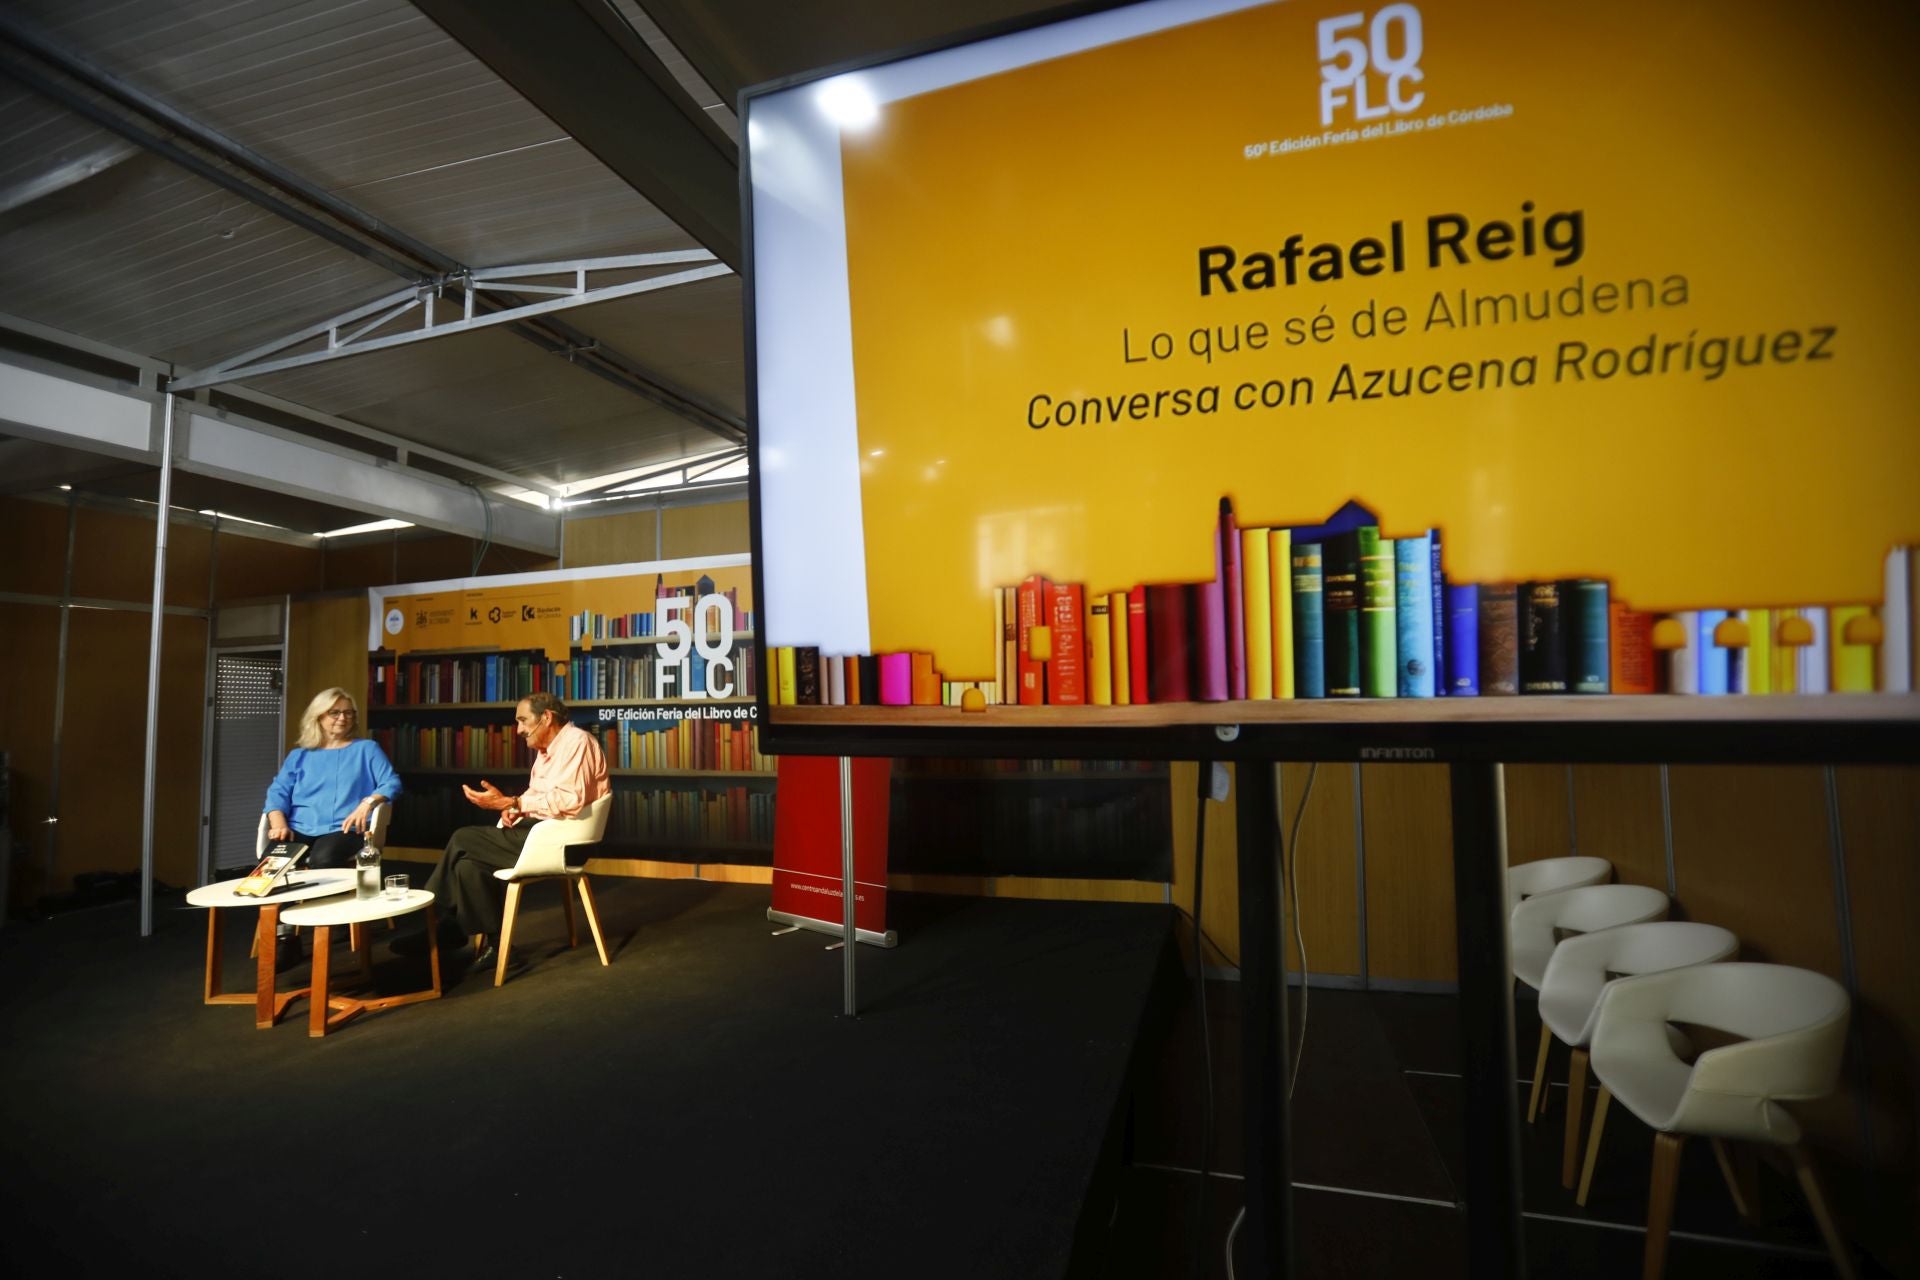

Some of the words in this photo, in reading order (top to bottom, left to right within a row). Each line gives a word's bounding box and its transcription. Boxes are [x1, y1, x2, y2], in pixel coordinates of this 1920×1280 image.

[1318, 3, 1422, 86] 50
[1270, 134, 1321, 155] Edición
[1323, 127, 1359, 144] Feria
[1361, 123, 1384, 139] del
[1385, 117, 1424, 135] Libro
[1426, 113, 1446, 128] de
[1447, 103, 1514, 124] Córdoba
[1321, 66, 1425, 126] FLC
[1199, 220, 1405, 296] Rafael
[1427, 200, 1584, 268] Reig
[1123, 328, 1174, 363] Lo
[1188, 321, 1269, 364] que
[1284, 305, 1336, 346] sé
[1351, 299, 1408, 339] de
[1424, 273, 1690, 332] Almudena
[1027, 383, 1220, 429] Conversa
[1234, 375, 1314, 410] con
[1327, 354, 1538, 403] Azucena
[1555, 325, 1837, 382] Rodríguez
[656, 594, 733, 663] 50
[656, 656, 733, 700] FLC
[617, 708, 655, 721] Edición
[656, 707, 683, 720] Feria
[684, 707, 701, 719] del
[703, 706, 732, 719] Libro
[733, 706, 748, 718] de
